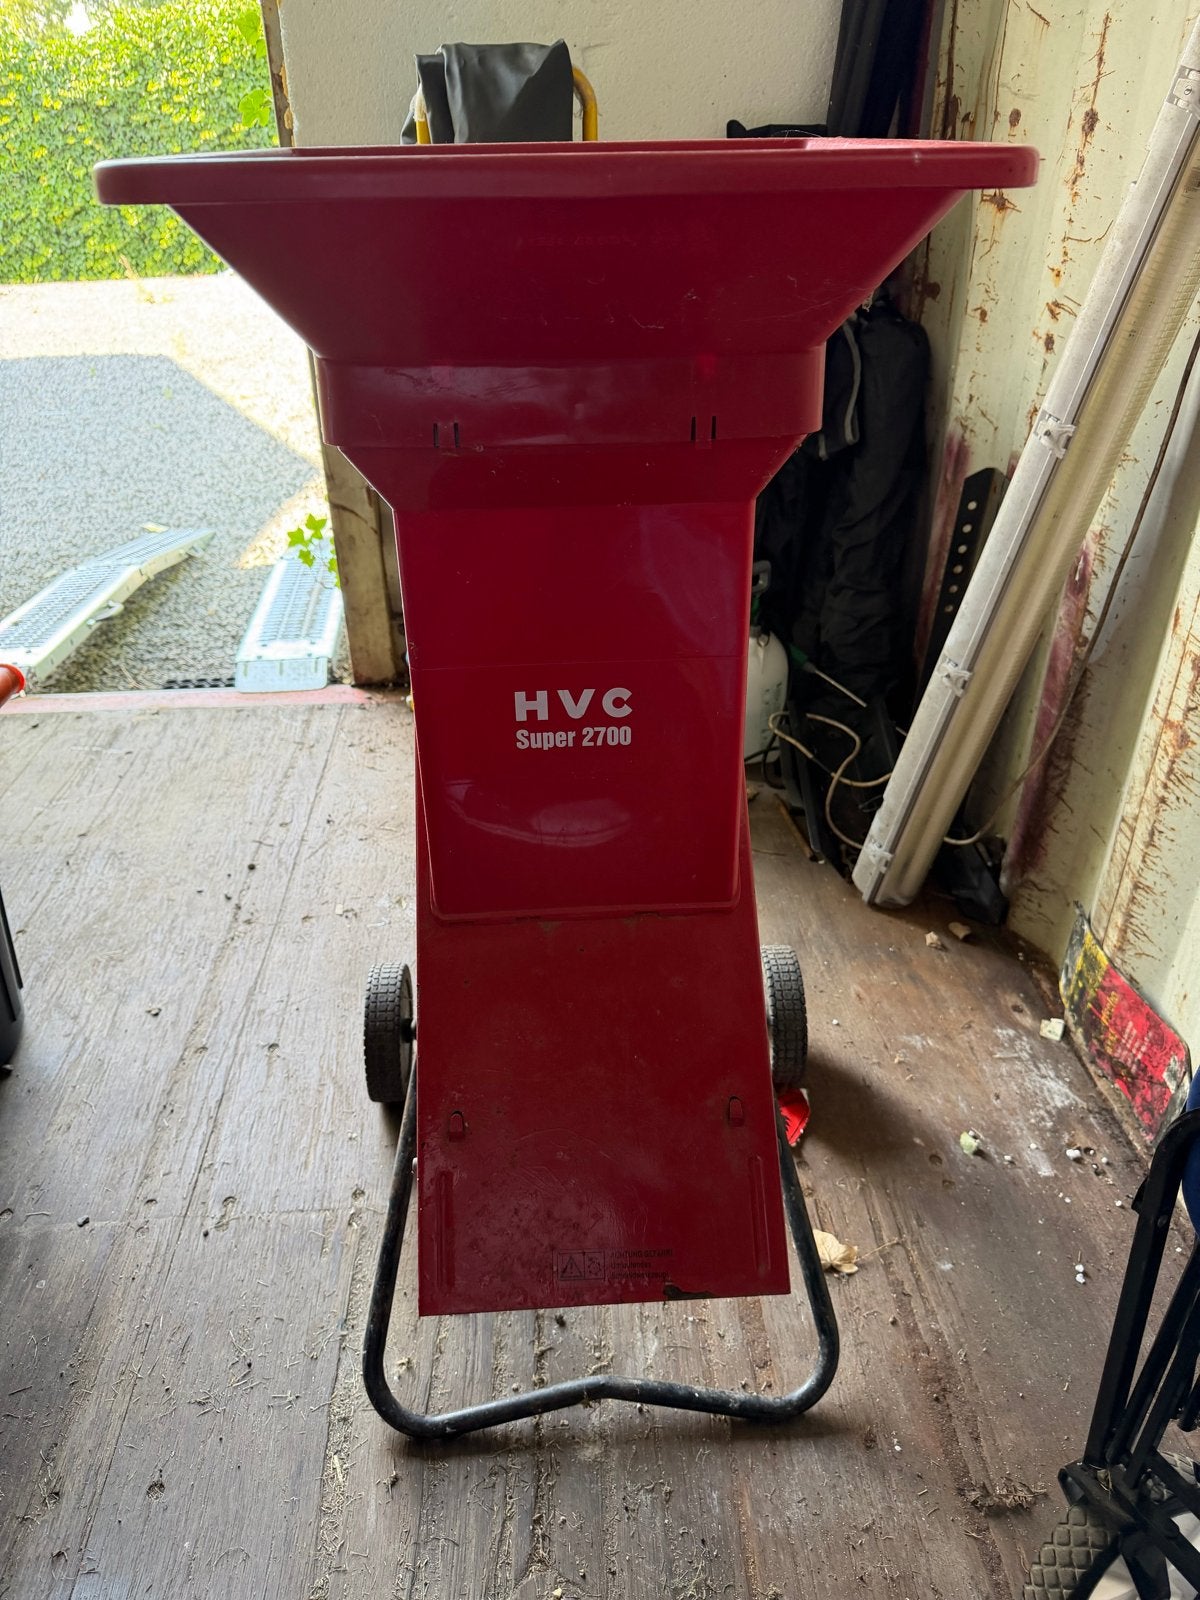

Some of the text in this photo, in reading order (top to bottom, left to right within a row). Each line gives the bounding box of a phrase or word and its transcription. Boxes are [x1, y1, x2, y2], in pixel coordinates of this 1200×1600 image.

[514, 687, 633, 722] HVC
[516, 725, 632, 750] Super 2700
